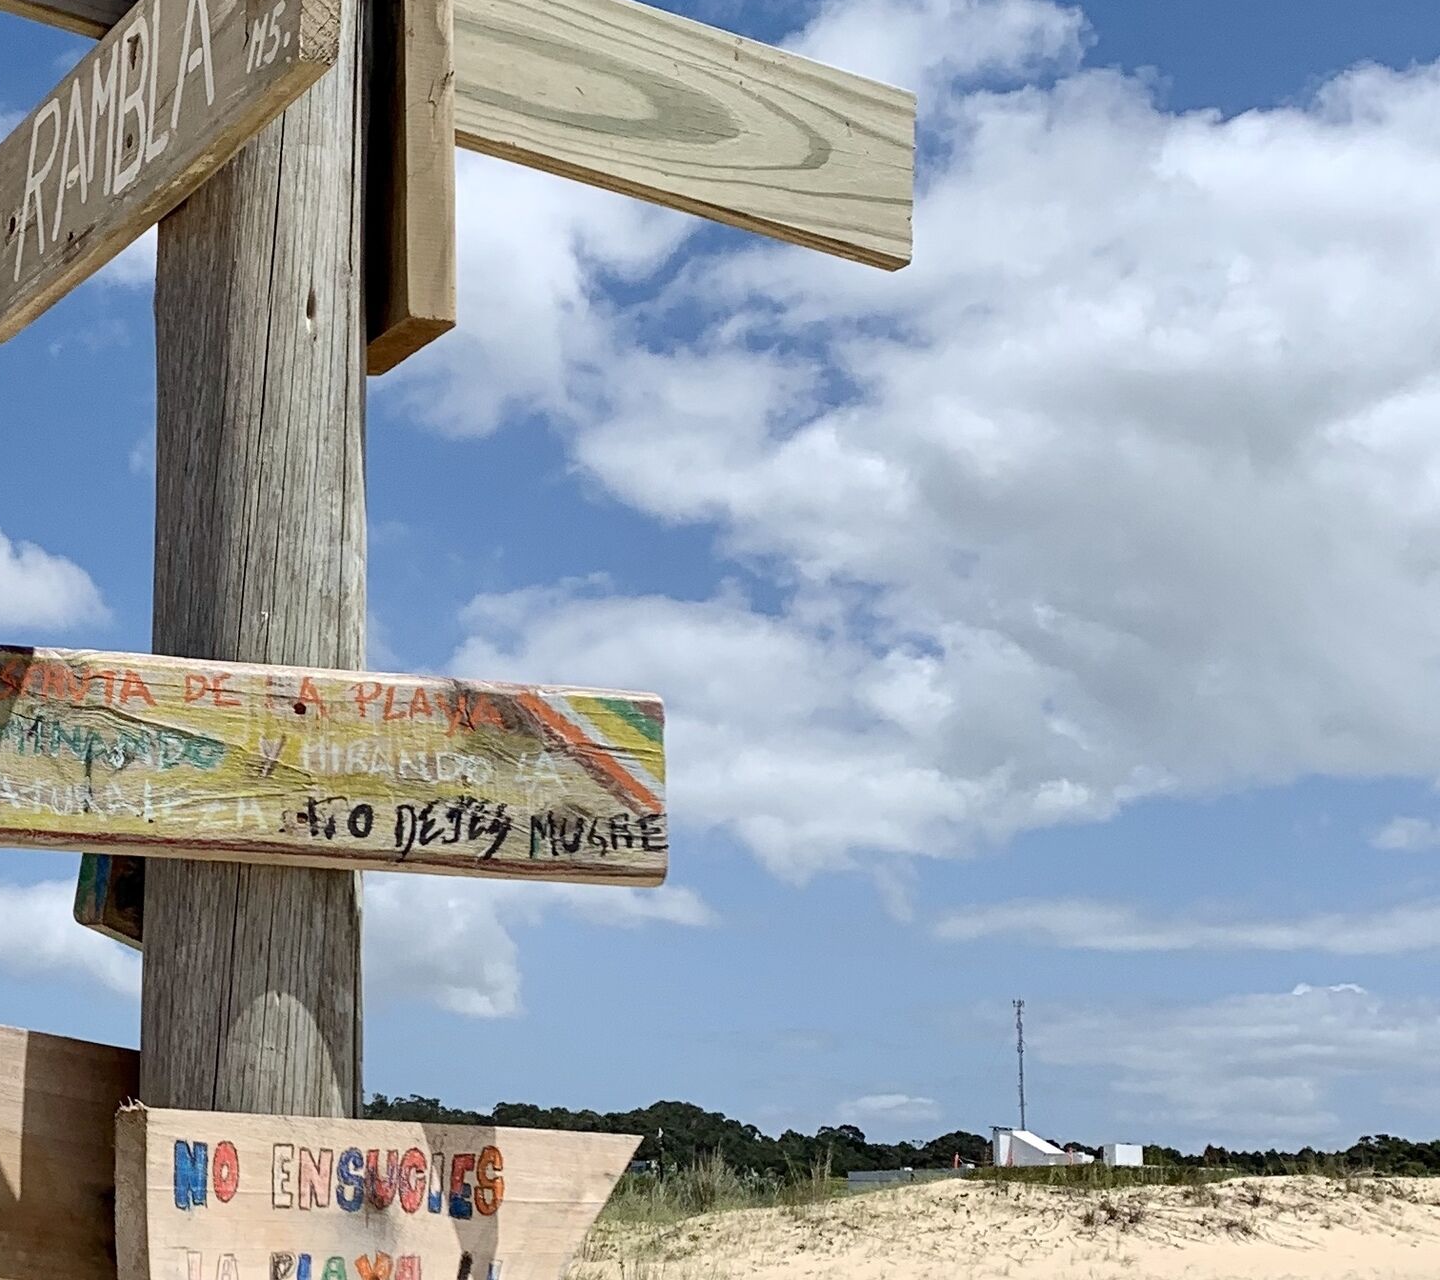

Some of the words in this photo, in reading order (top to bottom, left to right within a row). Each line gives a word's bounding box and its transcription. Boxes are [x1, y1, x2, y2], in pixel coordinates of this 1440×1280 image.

[184, 671, 243, 707] DE
[354, 680, 508, 737] PLAYA
[300, 732, 493, 786] MIRANDO
[514, 751, 566, 794] LA
[529, 809, 669, 860] MUGRE
[173, 1139, 240, 1210] NO
[271, 1144, 505, 1219] ENSUCIES
